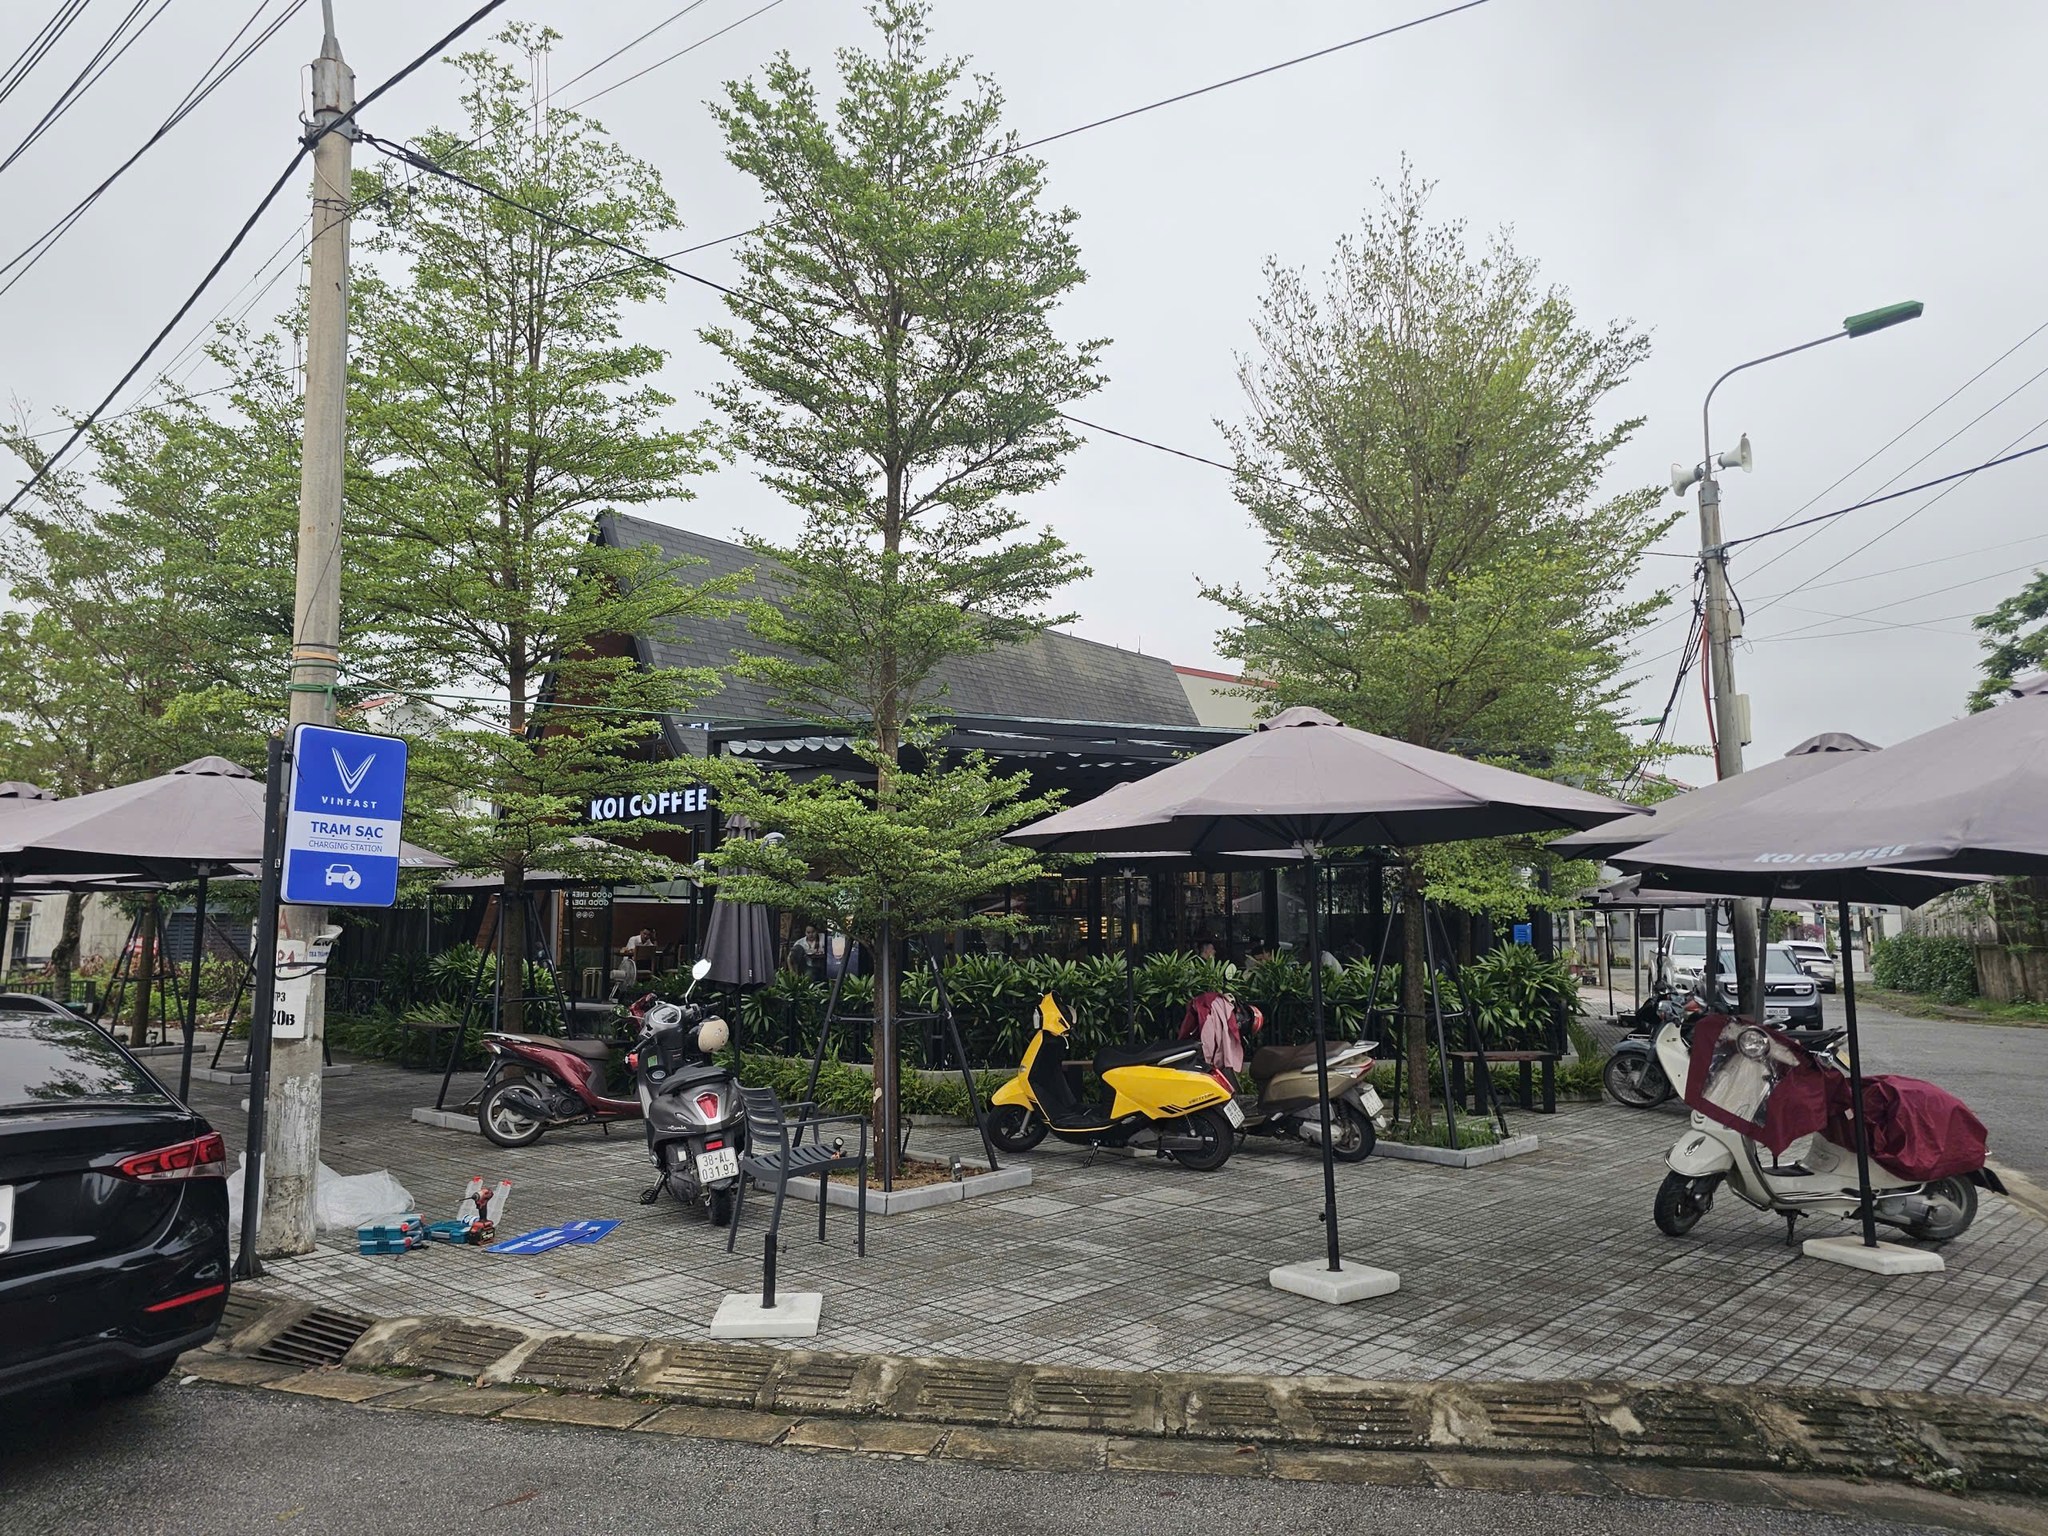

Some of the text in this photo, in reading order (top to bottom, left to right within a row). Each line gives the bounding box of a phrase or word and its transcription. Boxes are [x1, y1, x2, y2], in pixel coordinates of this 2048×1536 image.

[321, 795, 378, 809] VINFAST
[591, 788, 707, 820] KOI COFFEE
[310, 821, 384, 840] TRẠM SẠC
[308, 839, 383, 853] CHARGING STATION
[1754, 843, 1907, 864] KOI COFFEE
[702, 1152, 730, 1168] 38-AL
[701, 1162, 736, 1181] 031.92
